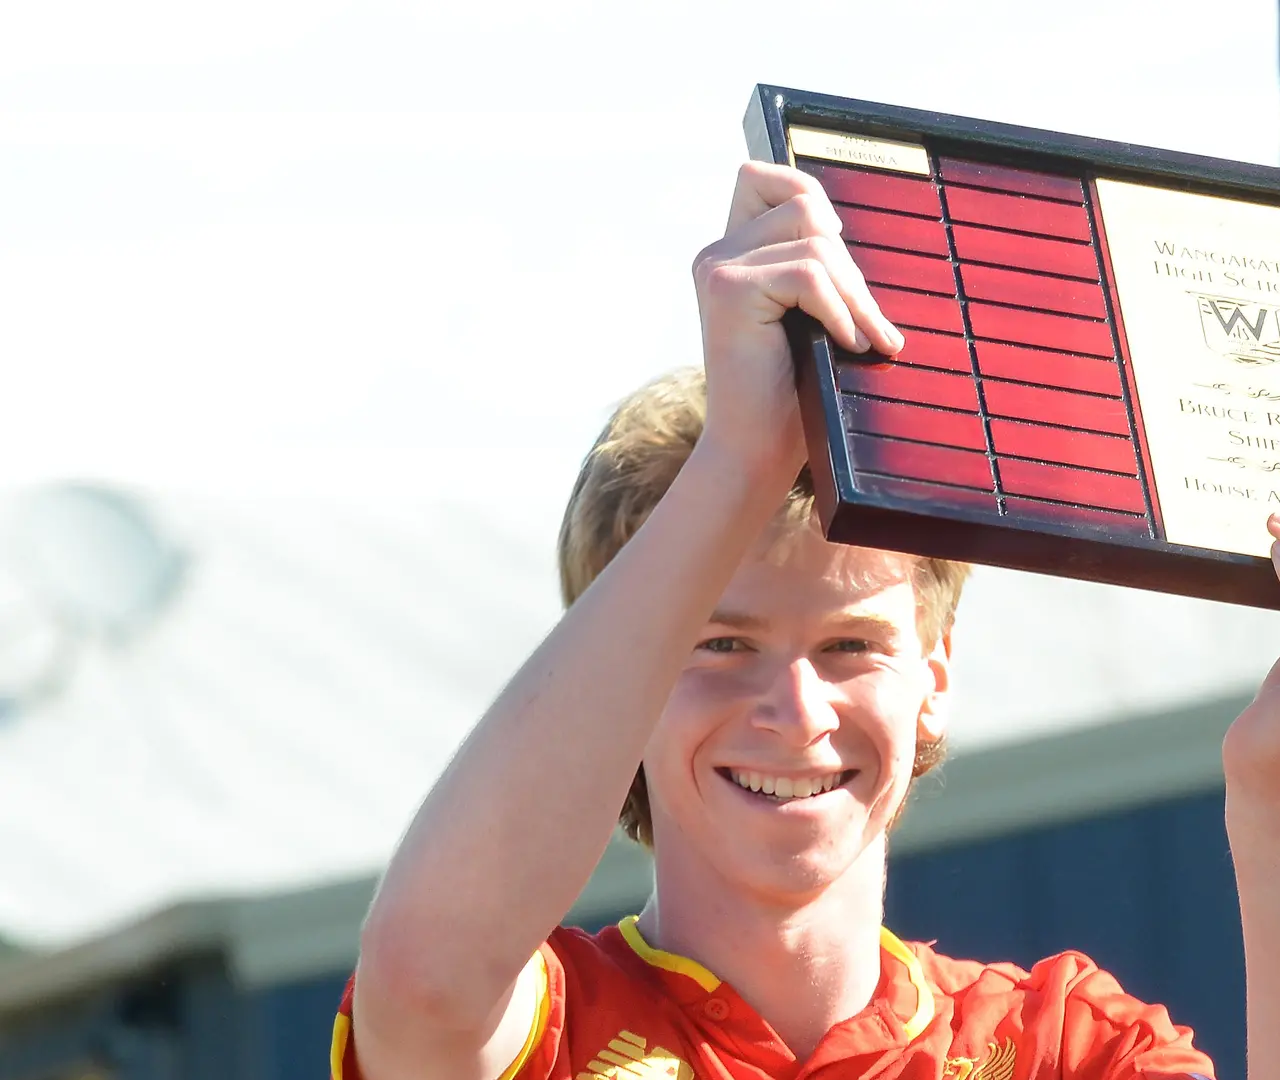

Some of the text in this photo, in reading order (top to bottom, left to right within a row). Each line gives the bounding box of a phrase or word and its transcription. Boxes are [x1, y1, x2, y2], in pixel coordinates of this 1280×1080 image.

[1153, 260, 1213, 283] HIGH
[1178, 398, 1257, 425] BRUCE
[1183, 476, 1258, 501] HOUSE
